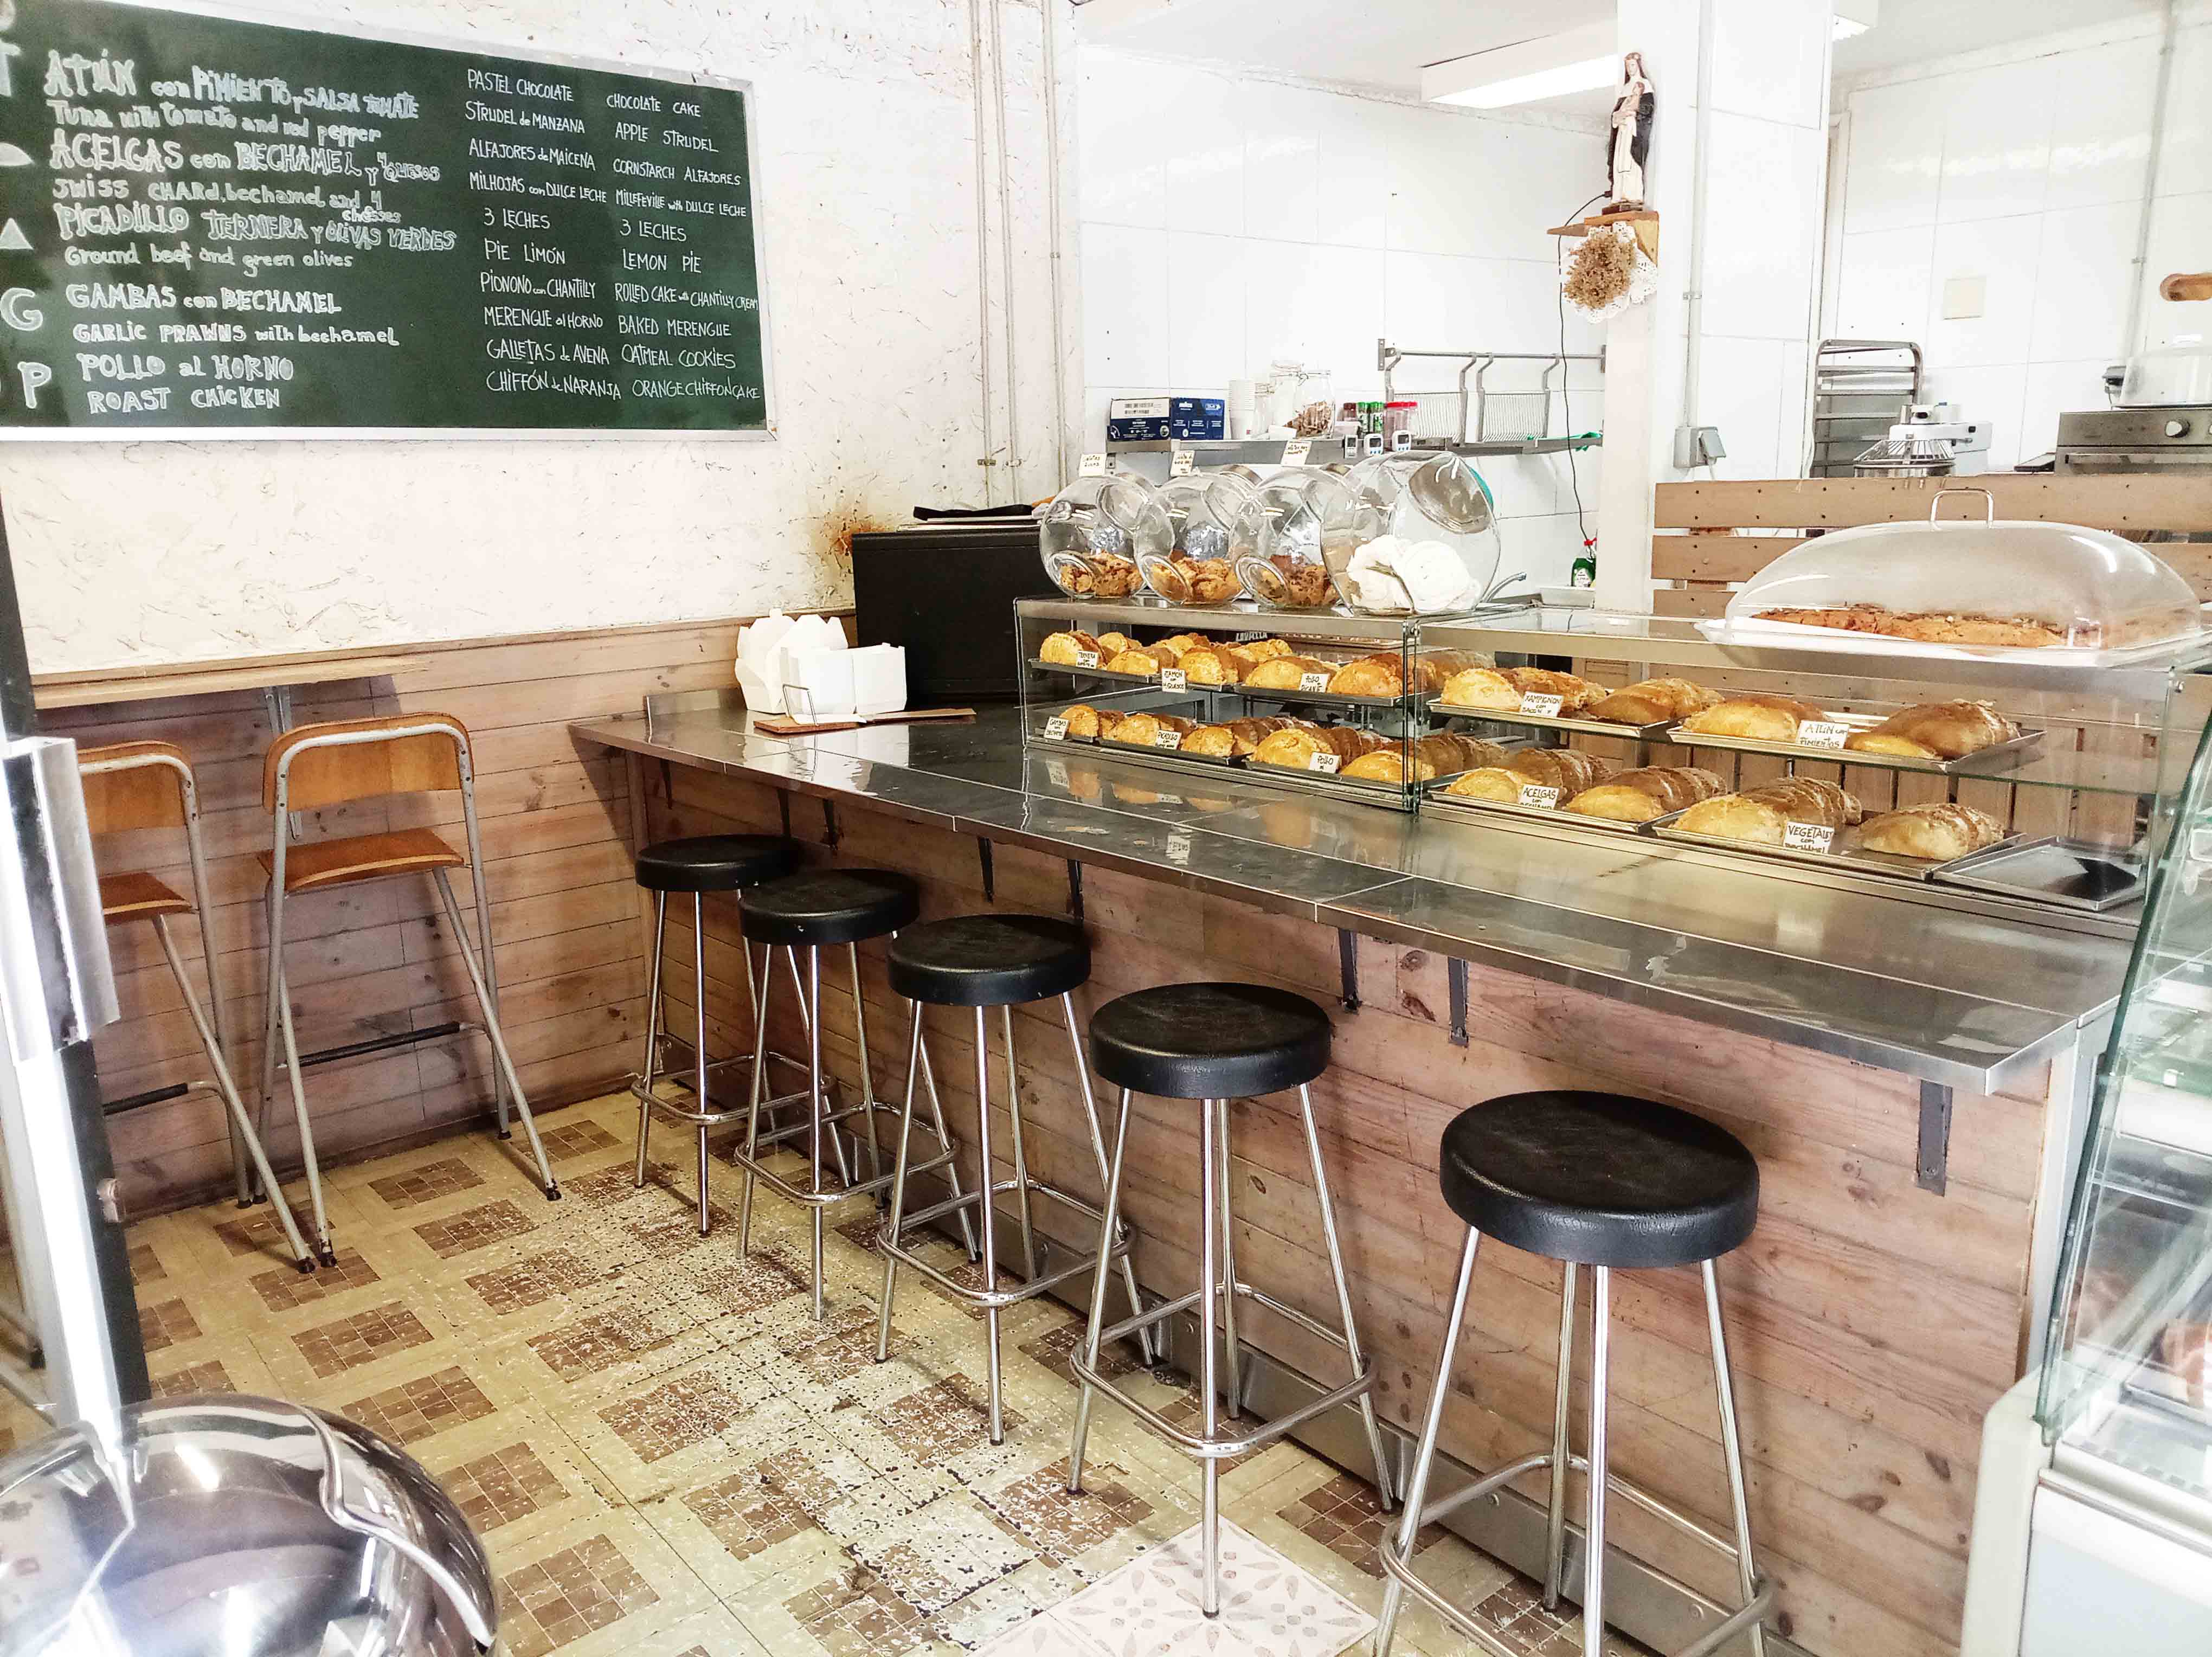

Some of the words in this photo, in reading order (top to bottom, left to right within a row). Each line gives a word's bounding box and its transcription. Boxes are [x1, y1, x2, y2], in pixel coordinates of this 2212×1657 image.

[43, 49, 137, 97] ATÚN
[151, 81, 191, 98] con
[303, 87, 360, 113] SALSA
[467, 68, 513, 94] PASTEL
[516, 79, 574, 101] CHOCOLATE
[465, 100, 517, 125] STRUDEL
[519, 111, 530, 126] de
[532, 112, 585, 133] MANZANA
[606, 93, 661, 112] CHOCOLATE
[673, 101, 701, 117] CAKE
[47, 99, 113, 128] Tuna
[241, 114, 278, 133] and
[317, 124, 381, 147] pepper
[469, 137, 536, 161] ALFAJORES
[538, 147, 549, 161] de
[615, 121, 649, 142] APPLE
[663, 130, 719, 152] STRUDEL
[49, 129, 184, 172] ACELGAS
[190, 152, 231, 170] con
[234, 142, 362, 176] BECHAMEL
[383, 162, 441, 182] QUESOS
[613, 158, 674, 179] CORNSTARCH
[684, 166, 742, 185] ALFAJORES
[529, 186, 545, 196] con
[545, 182, 576, 199] DULCE
[579, 186, 607, 203] LECHE
[484, 208, 495, 226] 3
[503, 208, 550, 229] LECHES
[685, 201, 714, 214] DULCE
[719, 203, 747, 217] LECHE
[201, 209, 308, 241] TERNERA
[387, 227, 457, 252] VERDES
[620, 219, 631, 235] 3
[639, 220, 686, 242] LECHES
[65, 242, 141, 266] Ground
[150, 241, 192, 271] beef
[199, 246, 235, 265] and
[242, 252, 294, 278] green
[303, 249, 353, 267] olives
[622, 248, 666, 270] LEMON
[0, 287, 43, 331] G
[66, 282, 177, 310] GAMBAS
[183, 296, 217, 309] con
[221, 287, 342, 314] BECHAMEL
[615, 282, 649, 303] ROLLED
[651, 286, 677, 302] CAKE
[735, 296, 758, 311] CREAM
[484, 306, 552, 327] MERENGUE
[555, 313, 565, 327] al
[568, 312, 603, 329] HORNO
[618, 315, 659, 335] BAKED
[667, 319, 731, 337] MERENGUE
[159, 322, 247, 343] PRAWNS
[255, 325, 294, 342] with
[486, 338, 555, 362] GALLETAS
[560, 345, 570, 361] de
[573, 344, 609, 364] AVENA
[621, 343, 673, 366] OATMEAL
[76, 353, 166, 382] POLLO
[211, 355, 294, 381] HORNO
[17, 361, 52, 408] P
[563, 375, 621, 400] NARANJA
[632, 379, 684, 399] ORANGE
[732, 385, 760, 399] CAKE
[87, 387, 171, 414] ROAST
[1522, 787, 1557, 800] ACELGAS
